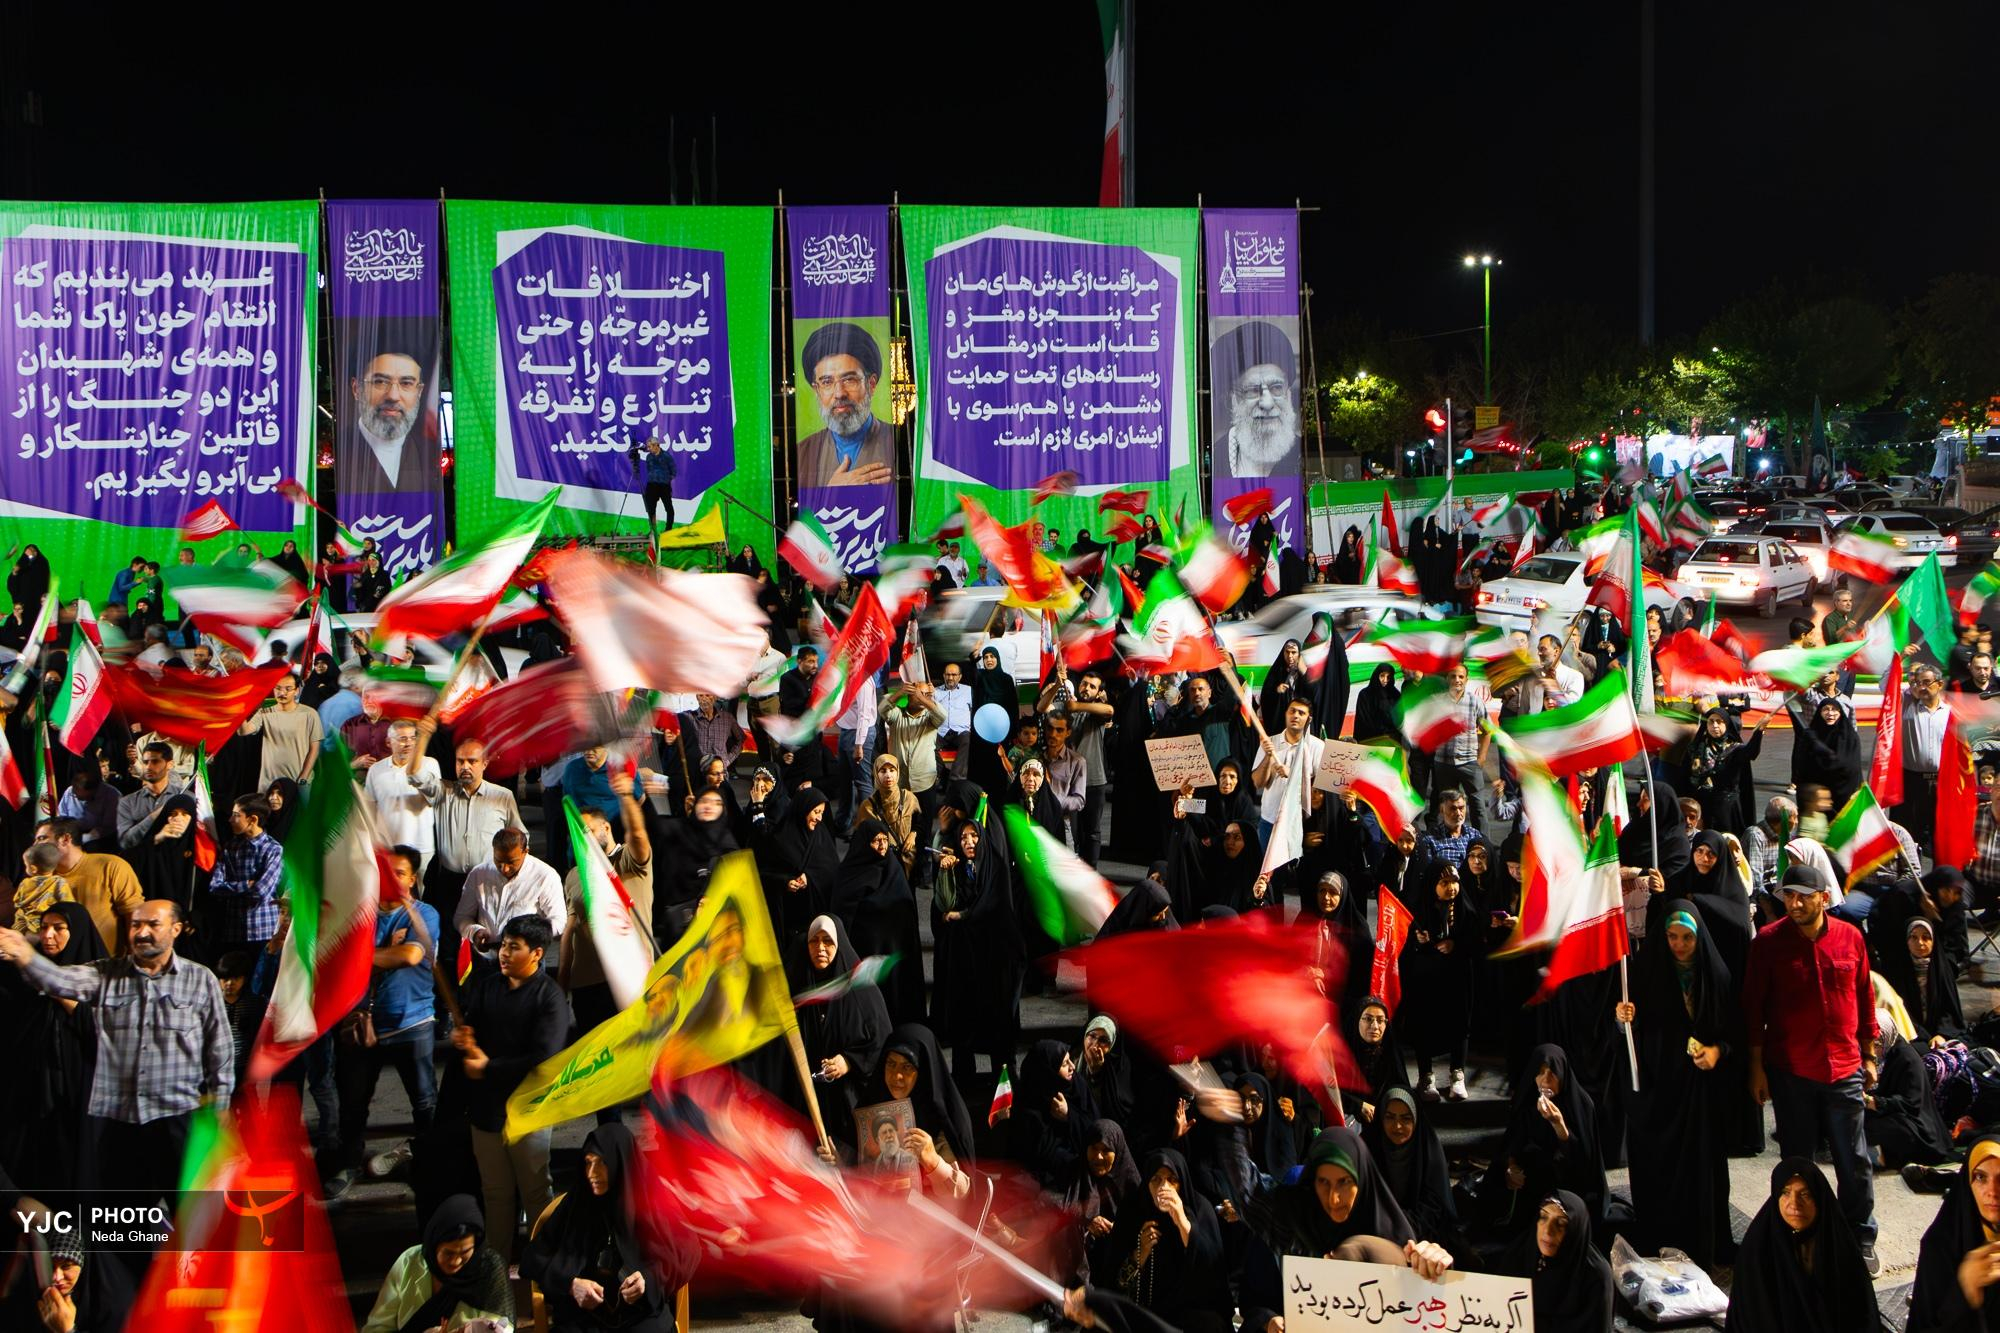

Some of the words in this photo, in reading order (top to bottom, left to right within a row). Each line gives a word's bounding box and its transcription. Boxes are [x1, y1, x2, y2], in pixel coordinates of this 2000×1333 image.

[13, 261, 49, 289] که
[183, 266, 275, 296] عهد
[517, 265, 710, 298] اختلافات
[1078, 272, 1092, 297] از
[1093, 269, 1158, 297] مراقبت
[14, 300, 72, 329] شما
[80, 300, 127, 341] پاک
[135, 302, 197, 336] خون
[204, 300, 276, 338] انتقام
[945, 310, 956, 328] و
[963, 304, 1025, 328] مغز
[1028, 306, 1121, 330] پنجره
[1125, 302, 1161, 321] که
[517, 314, 573, 344] حتی
[578, 320, 594, 345] و
[1050, 334, 1106, 352] است
[947, 334, 1029, 358] مقابل
[1028, 338, 1048, 359] در
[1108, 330, 1160, 358] قلب
[17, 342, 163, 376] شهیدان
[261, 348, 278, 374] و
[518, 351, 576, 383] به
[584, 348, 600, 384] را
[947, 365, 1009, 389] حمایت
[1014, 366, 1057, 384] تحت
[12, 383, 36, 418] از
[42, 382, 60, 418] را
[67, 379, 192, 416] جنگ
[198, 387, 231, 416] دو
[238, 379, 278, 414] این
[519, 382, 596, 422] تفرقه
[599, 398, 616, 422] و
[622, 387, 711, 425] تنازع
[948, 396, 960, 420] با
[1063, 396, 1075, 419] یا
[1081, 395, 1161, 420] دشمن
[18, 434, 35, 458] و
[38, 421, 192, 458] جنایتکار
[200, 414, 279, 455] قاتلین
[551, 425, 630, 460] نکنید.
[994, 426, 1040, 446] است.
[1042, 426, 1071, 452] لازم
[1074, 426, 1113, 450] امری
[1116, 425, 1162, 449] ایشان
[85, 458, 190, 500] بگیریم.
[1333, 1279, 1379, 1318] کرده
[1366, 1288, 1412, 1324] عمل
[1505, 1291, 1528, 1333] اگر
[1404, 1296, 1447, 1331] رهبر
[1445, 1294, 1482, 1333] نظر
